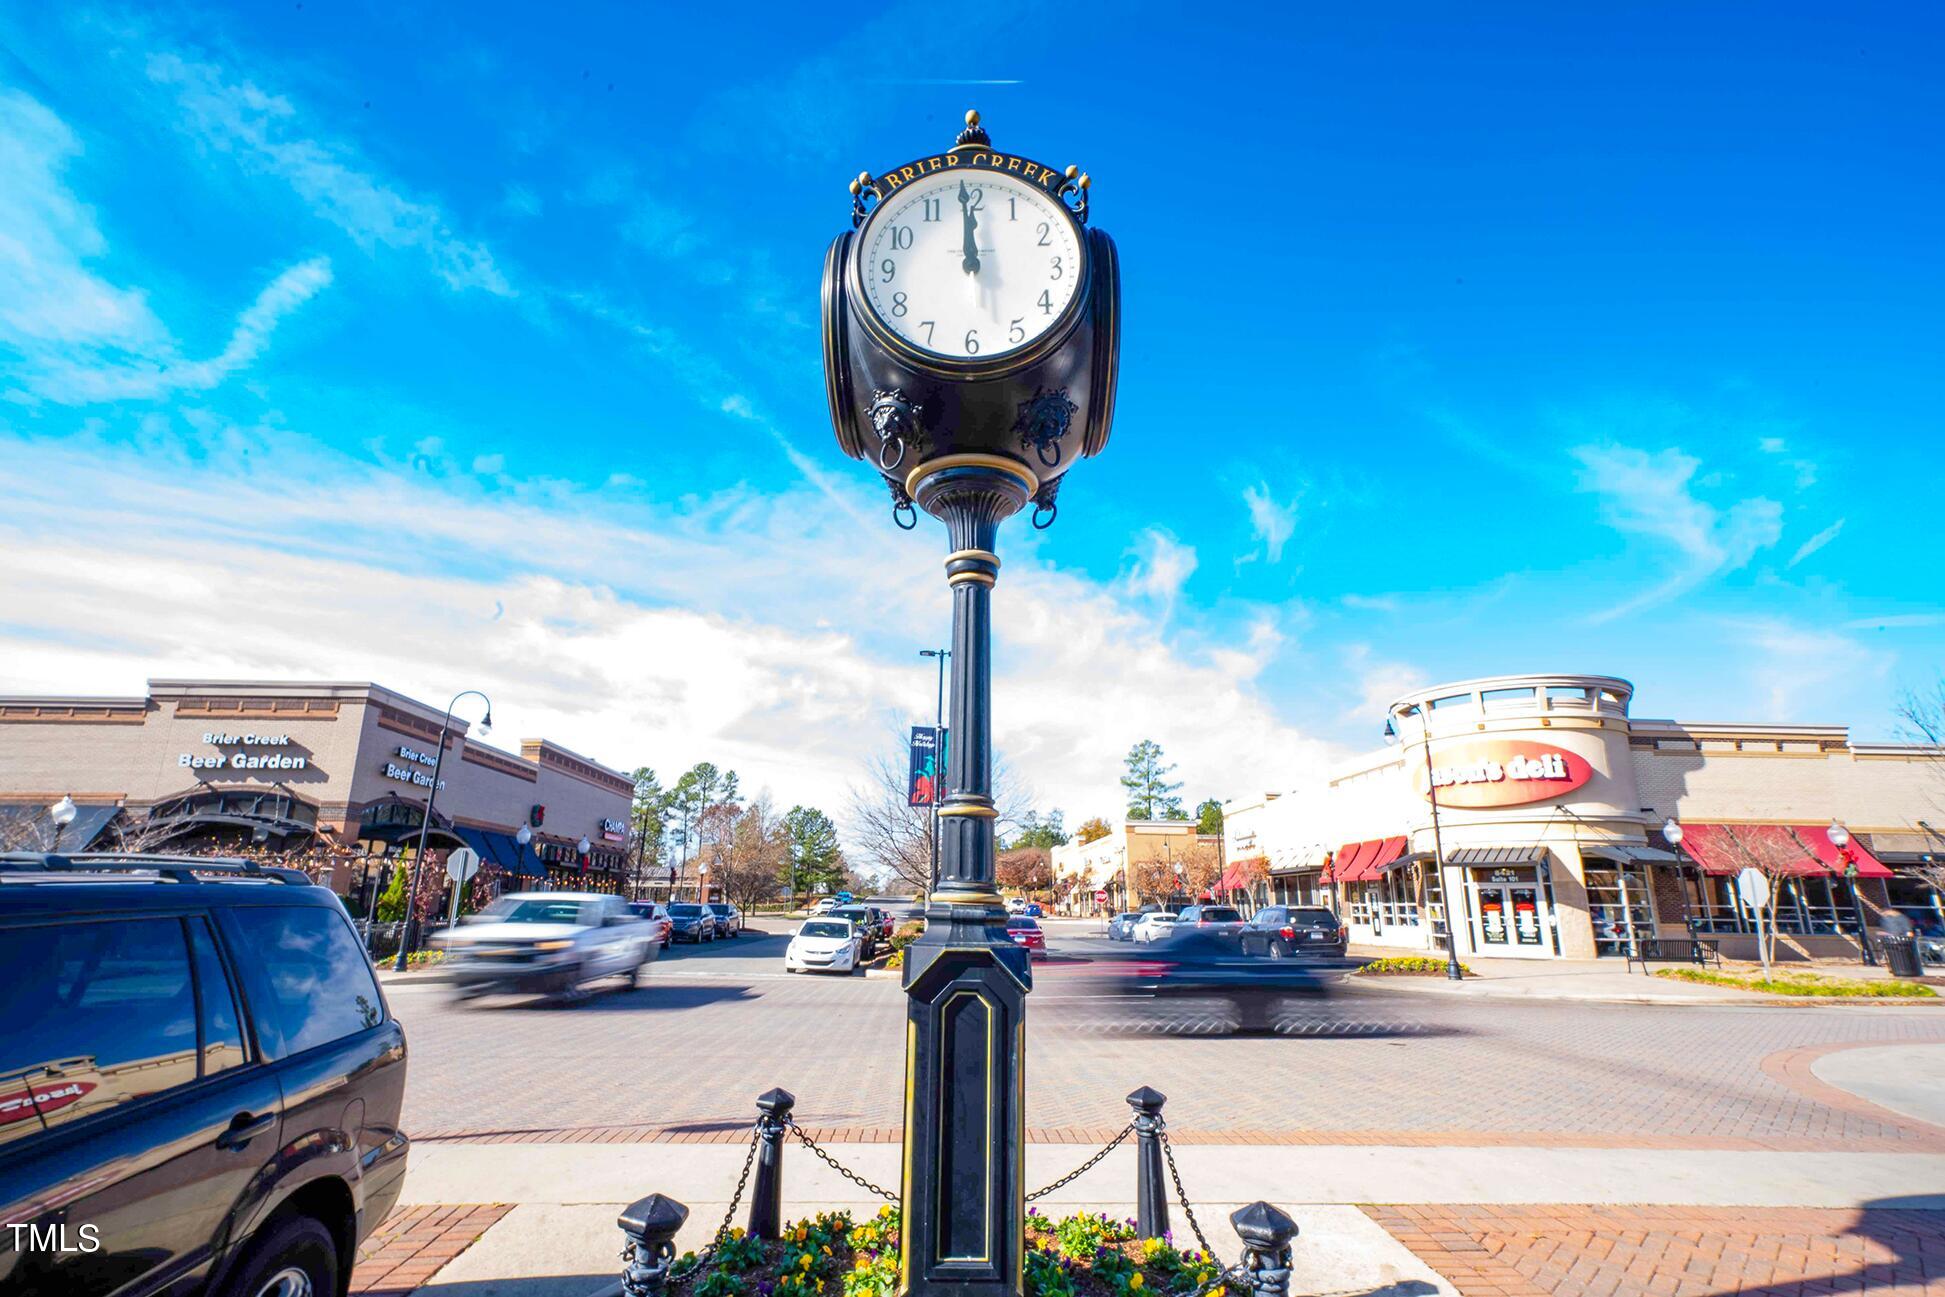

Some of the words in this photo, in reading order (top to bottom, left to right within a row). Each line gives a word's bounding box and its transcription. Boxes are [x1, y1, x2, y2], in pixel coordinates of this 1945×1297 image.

[884, 154, 960, 189] BRIER
[972, 153, 1057, 187] CREEK
[922, 198, 942, 222] 11
[1007, 197, 1019, 221] 1
[889, 226, 914, 250] 10
[1036, 222, 1053, 247] 2
[881, 258, 896, 283] 9
[1049, 256, 1064, 281] 3
[891, 291, 908, 318] 8
[1036, 289, 1054, 315] 4
[918, 321, 936, 348] 7
[964, 329, 980, 356] 6
[1007, 316, 1026, 345] 5
[202, 732, 241, 744] Brier
[243, 734, 290, 745] Creek
[178, 753, 227, 768] Beer
[231, 753, 306, 769] Garden
[400, 746, 419, 762] Brier
[419, 753, 438, 767] Cree
[386, 763, 412, 782] Beer
[1427, 760, 1505, 795] ason's
[1507, 753, 1567, 779] deli
